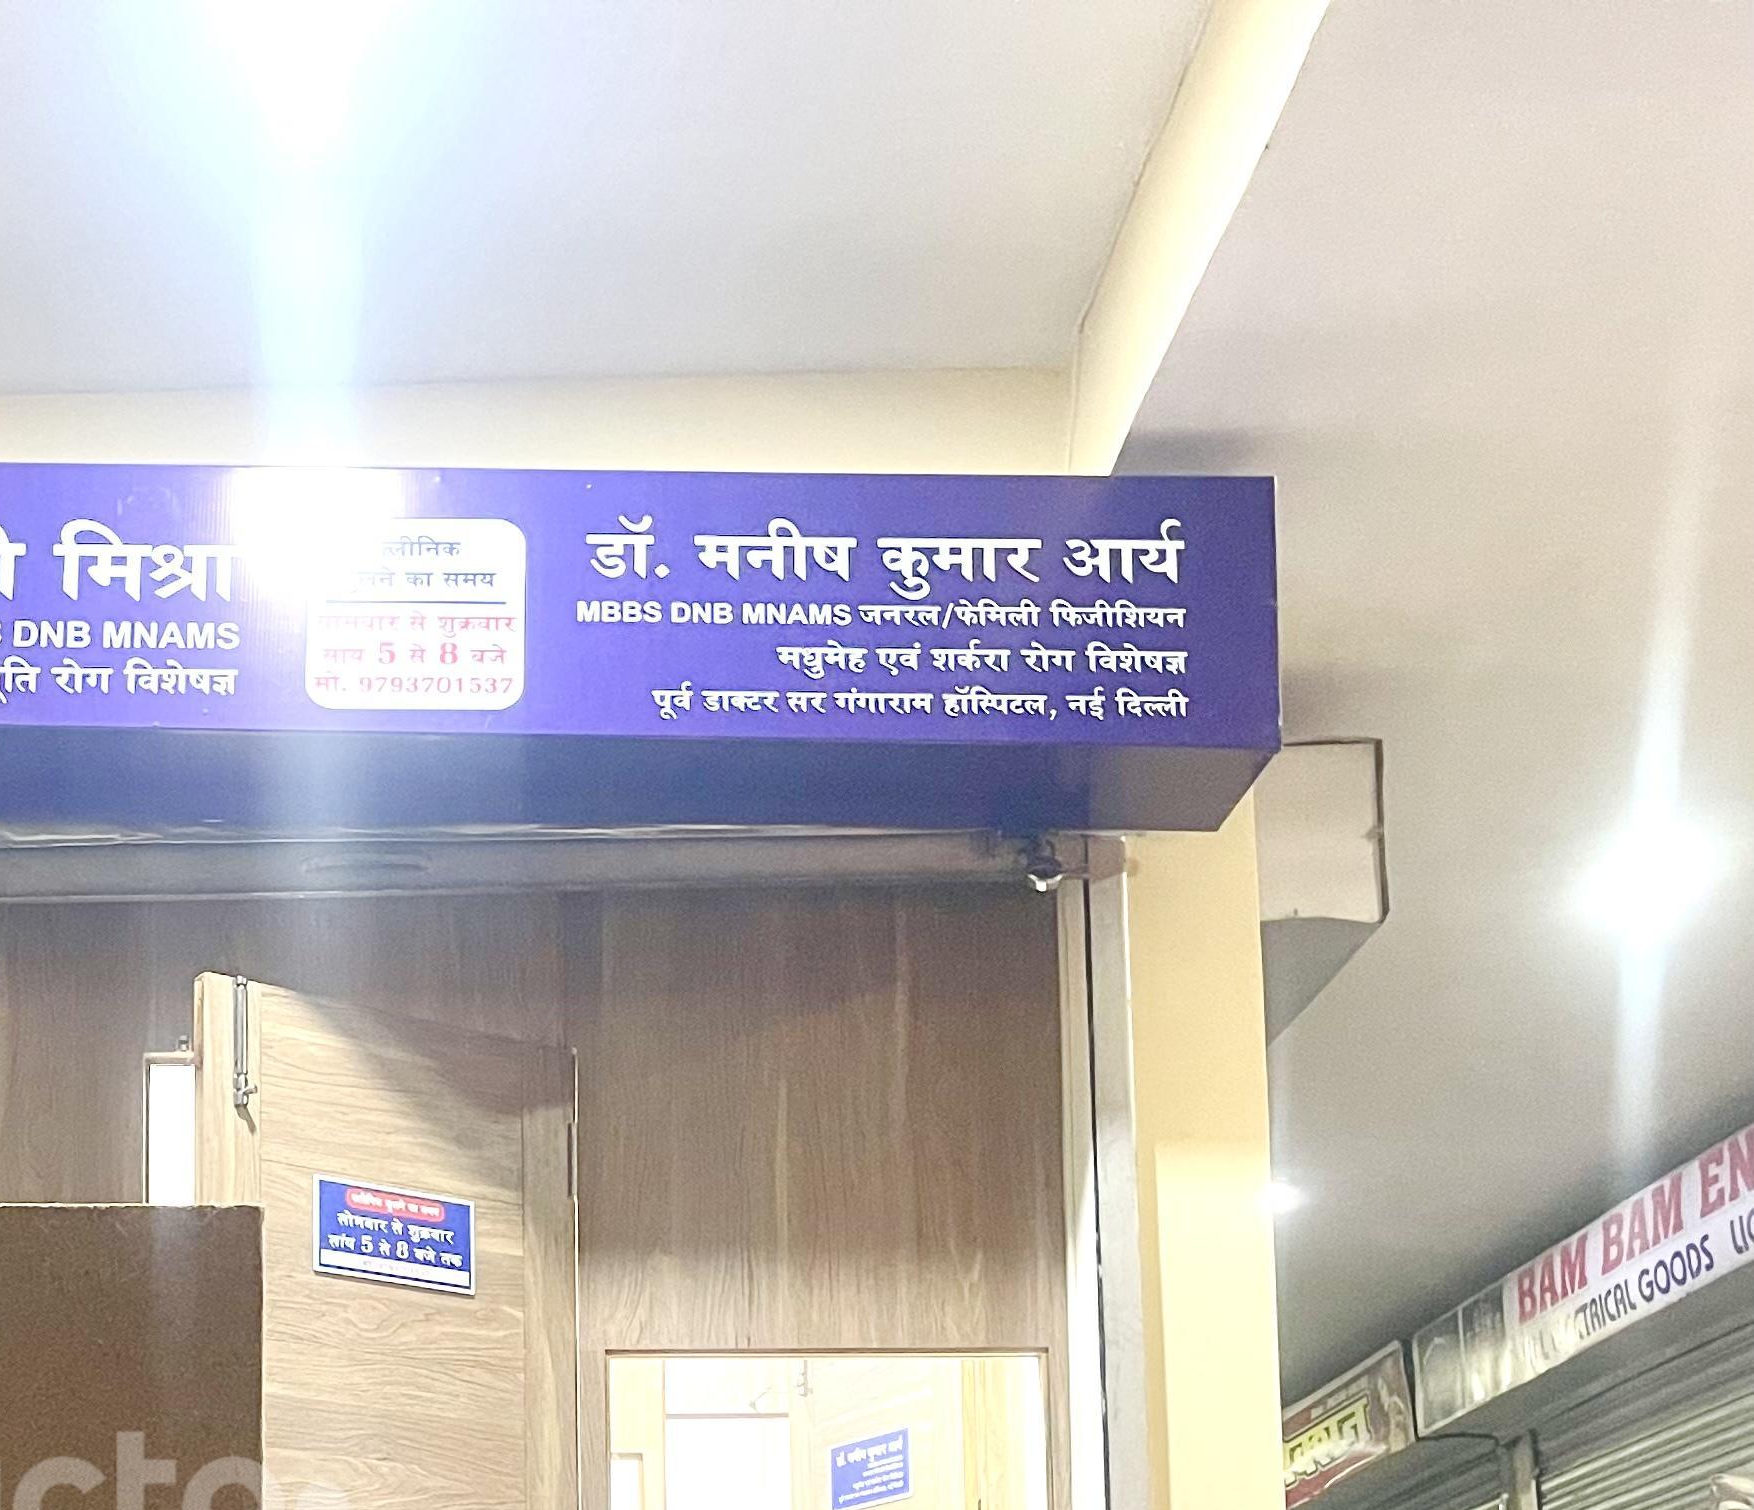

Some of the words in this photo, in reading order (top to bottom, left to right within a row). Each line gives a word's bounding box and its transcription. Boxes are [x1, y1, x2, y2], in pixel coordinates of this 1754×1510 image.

[54, 519, 241, 601] मिश्रा
[586, 515, 669, 578] डॉ.
[694, 518, 857, 581] मनीष
[877, 538, 1041, 600] कुमार
[1063, 519, 1184, 583] आर्य
[405, 572, 433, 587] का
[443, 572, 497, 587] समय
[437, 617, 517, 638] शुक्रवार
[577, 601, 662, 622] MBBS
[671, 601, 733, 624] DNB
[743, 603, 851, 625] MNAMS
[859, 599, 1041, 631] जनरल/फेमिली
[1049, 599, 1186, 627] फिजीशियन
[13, 621, 91, 648] DNB
[102, 621, 240, 649] MNAMS
[378, 642, 396, 664] 5
[439, 642, 458, 664] 8
[470, 644, 507, 664] बजे
[776, 640, 868, 679] मधुमेह
[875, 642, 921, 675] एवं
[930, 639, 1011, 671] शर्करा
[1020, 641, 1076, 672] रोग
[1085, 641, 1188, 674] विशेषज्ञ
[51, 658, 114, 693] रोग
[123, 657, 238, 695] विशेषज्ञ
[359, 677, 513, 693] 9793701537
[651, 681, 693, 719] पूर्व
[701, 691, 779, 712] डाक्टर
[786, 692, 827, 713] सर
[834, 683, 934, 715] गंगाराम
[1066, 686, 1105, 720] नई
[1115, 688, 1189, 717] दिल्ली
[360, 1236, 373, 1253] 5
[1517, 1231, 1589, 1325] BAM
[1601, 1169, 1684, 1276] BAM
[1637, 1233, 1714, 1303] GOODS
